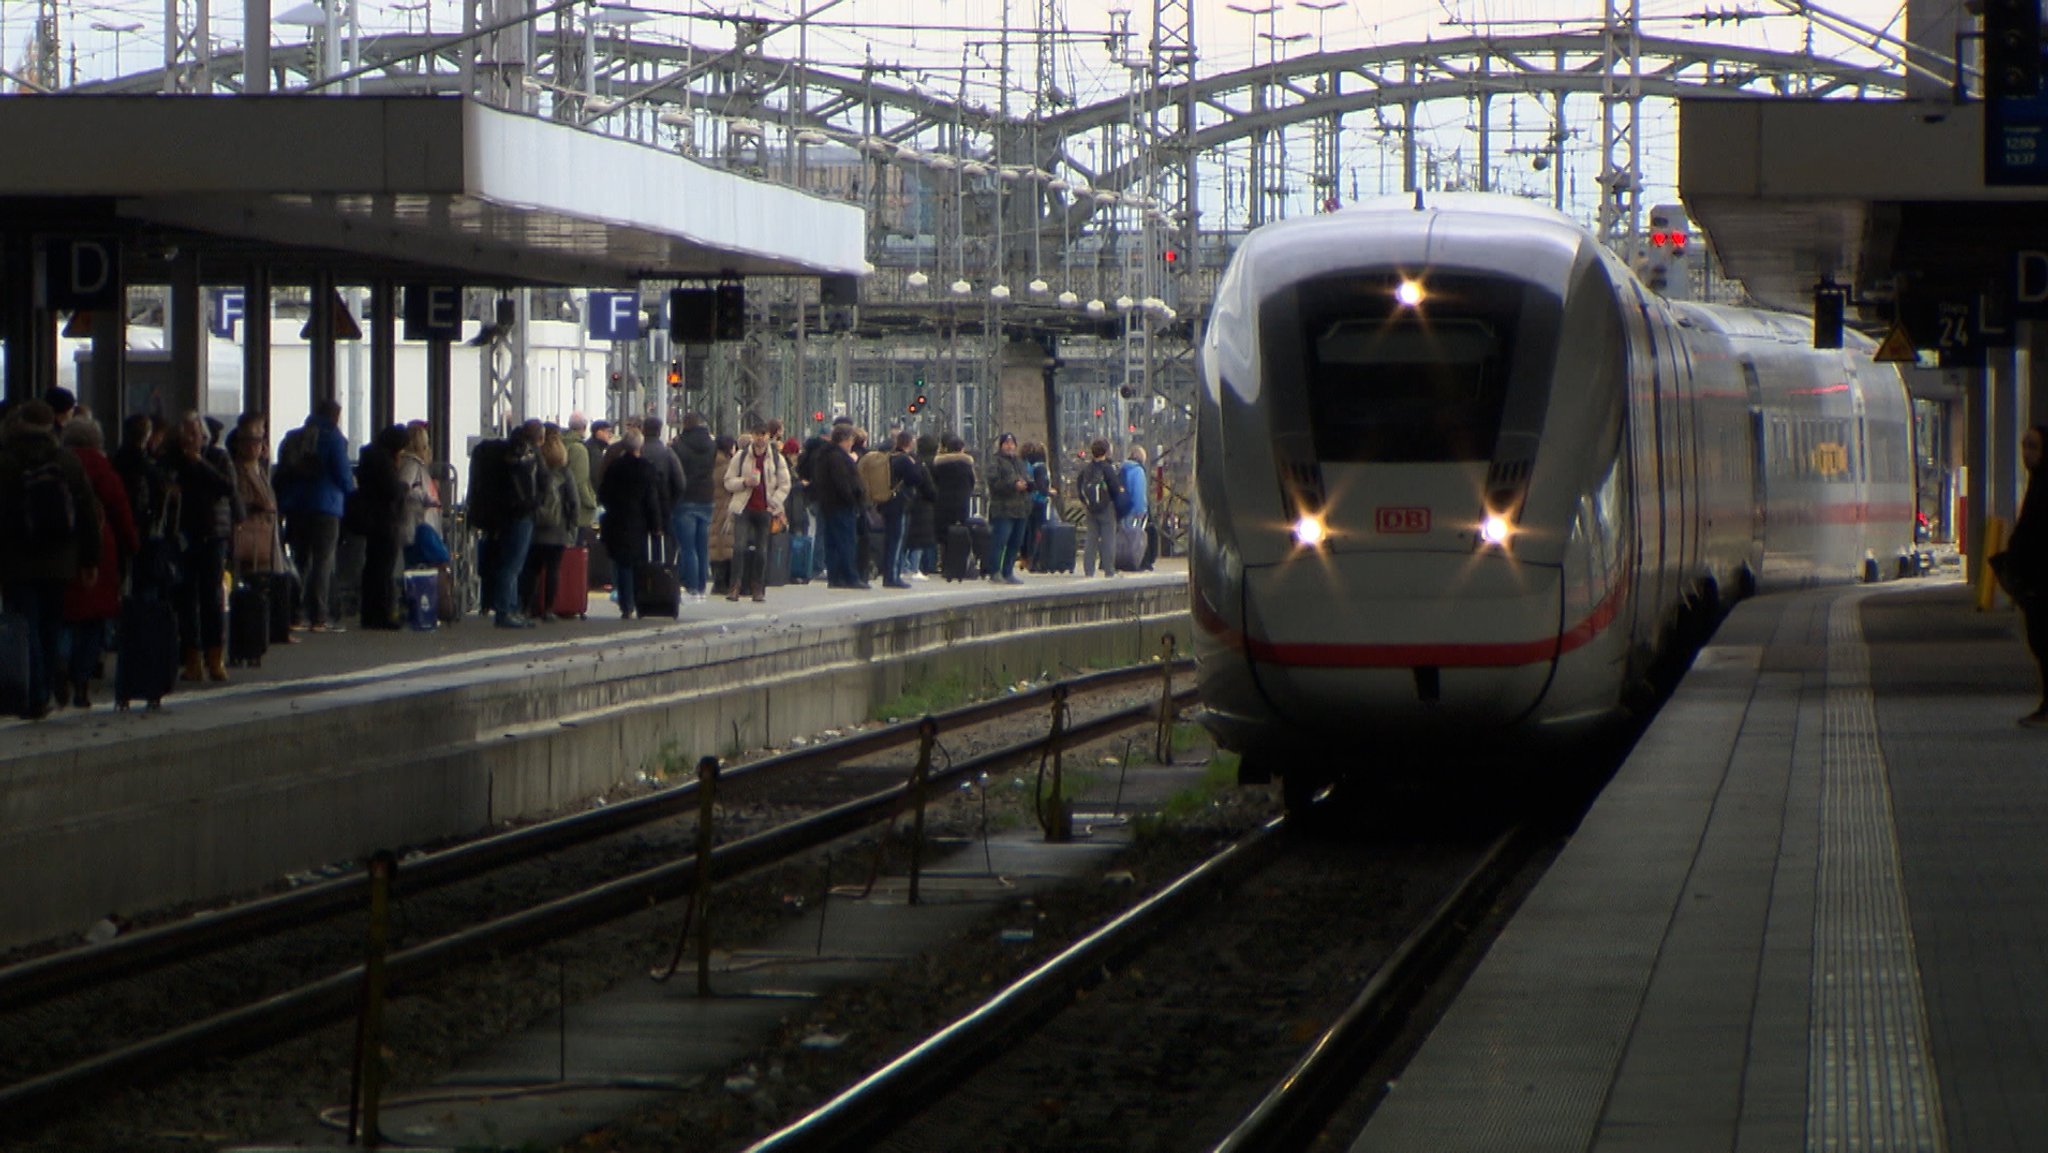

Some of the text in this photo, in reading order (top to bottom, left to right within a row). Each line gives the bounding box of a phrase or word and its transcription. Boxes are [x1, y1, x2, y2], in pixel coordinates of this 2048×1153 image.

[71, 241, 109, 294] D
[2016, 250, 2048, 303] D
[222, 294, 244, 329] F
[427, 287, 454, 327] E
[610, 296, 632, 331] F
[1938, 316, 1968, 347] 24
[1380, 508, 1427, 530] DB
